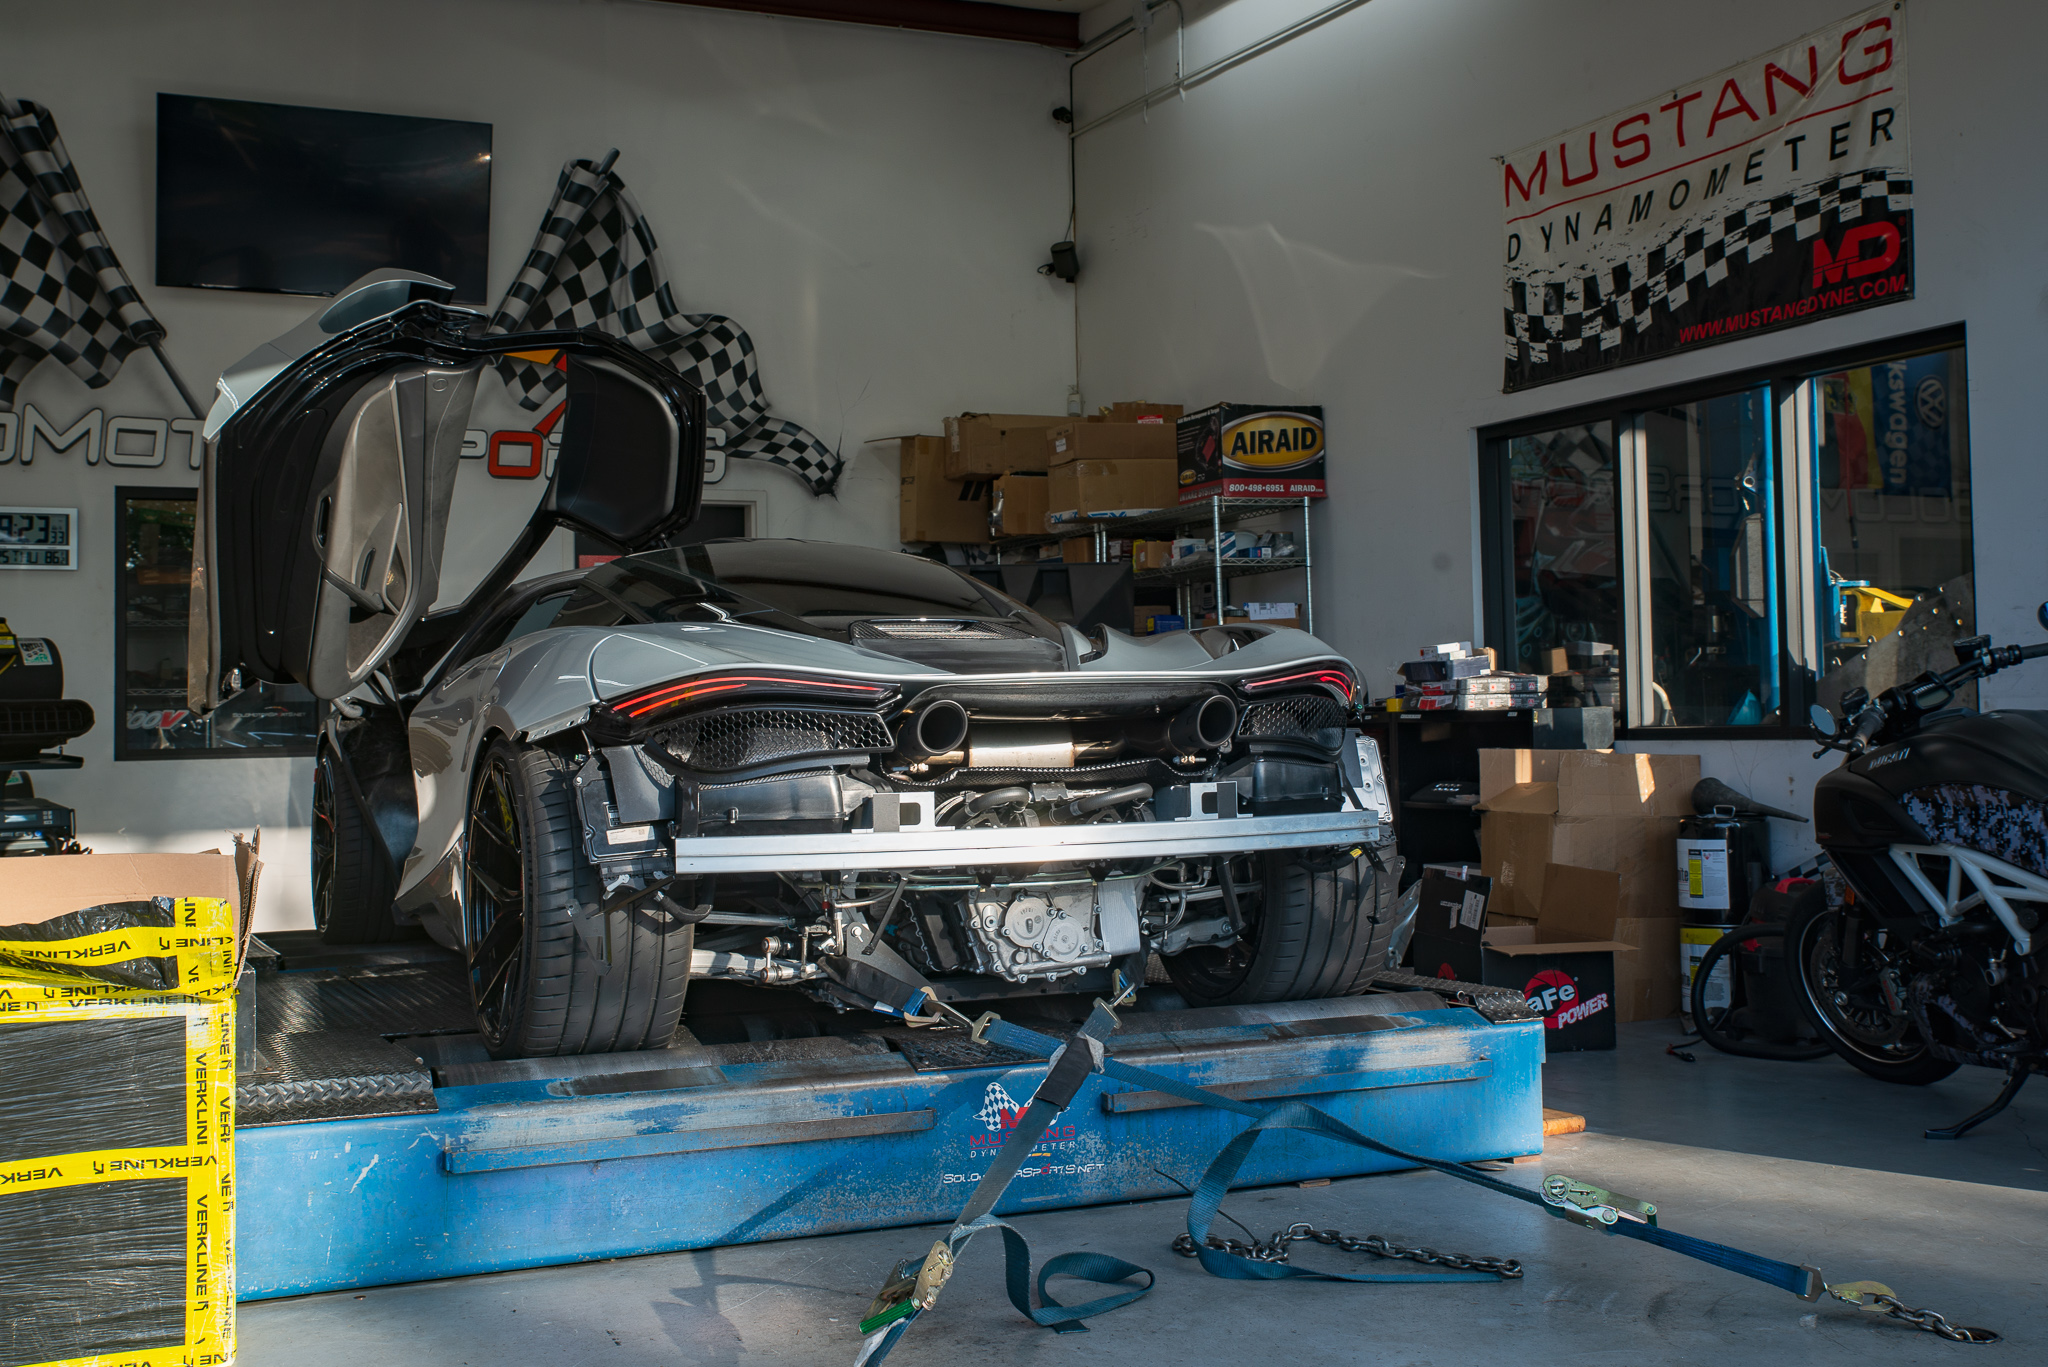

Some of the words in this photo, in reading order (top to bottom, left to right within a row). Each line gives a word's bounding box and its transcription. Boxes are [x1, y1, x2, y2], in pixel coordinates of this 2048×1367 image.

[1504, 16, 1894, 208] MUSTANG
[1506, 107, 1896, 264] DYNAMOMETER
[1812, 220, 1901, 290] MD
[1678, 273, 1907, 345] WWW.MUSTANGDYNE.COM
[1230, 426, 1318, 458] AIRAID
[1867, 747, 1911, 771] DUCATI
[1526, 984, 1576, 1012] aFe
[1557, 993, 1609, 1030] POWER
[110, 1155, 219, 1172] VERKLINE
[196, 1194, 209, 1297] VERKLINE
